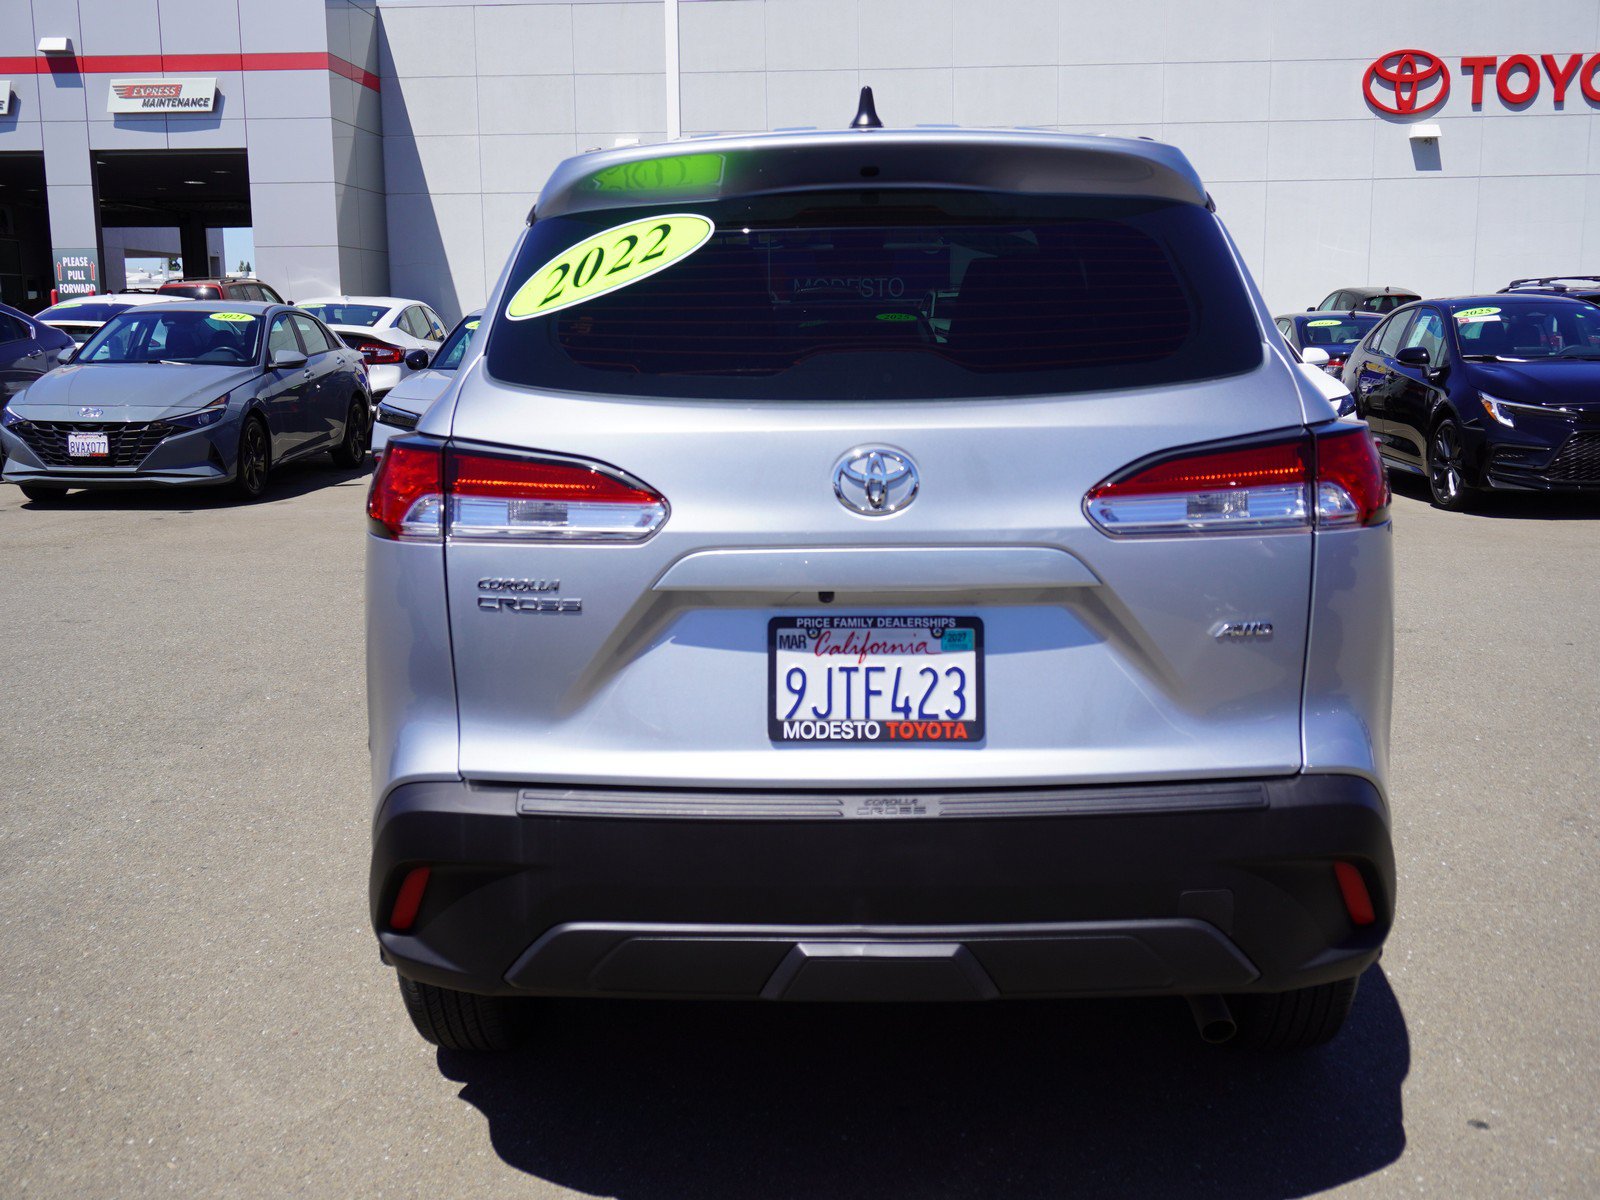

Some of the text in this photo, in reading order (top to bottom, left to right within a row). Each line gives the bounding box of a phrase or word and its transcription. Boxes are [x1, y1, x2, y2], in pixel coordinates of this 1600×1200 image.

[132, 86, 177, 96] EXPRESS
[141, 97, 210, 108] MAINTENANCE
[62, 257, 88, 267] PLEASE
[537, 223, 672, 308] 2022
[68, 270, 86, 280] PULL
[59, 284, 96, 293] FORWARD
[478, 578, 560, 592] COROLLA
[478, 595, 582, 611] CROSS
[796, 618, 956, 628] PRICE FAMILY DEALERSHIPS
[779, 634, 807, 650] MAR
[814, 630, 942, 664] California
[784, 666, 966, 720] 9JTF423
[783, 721, 968, 740] MODESTO TOYOTA
